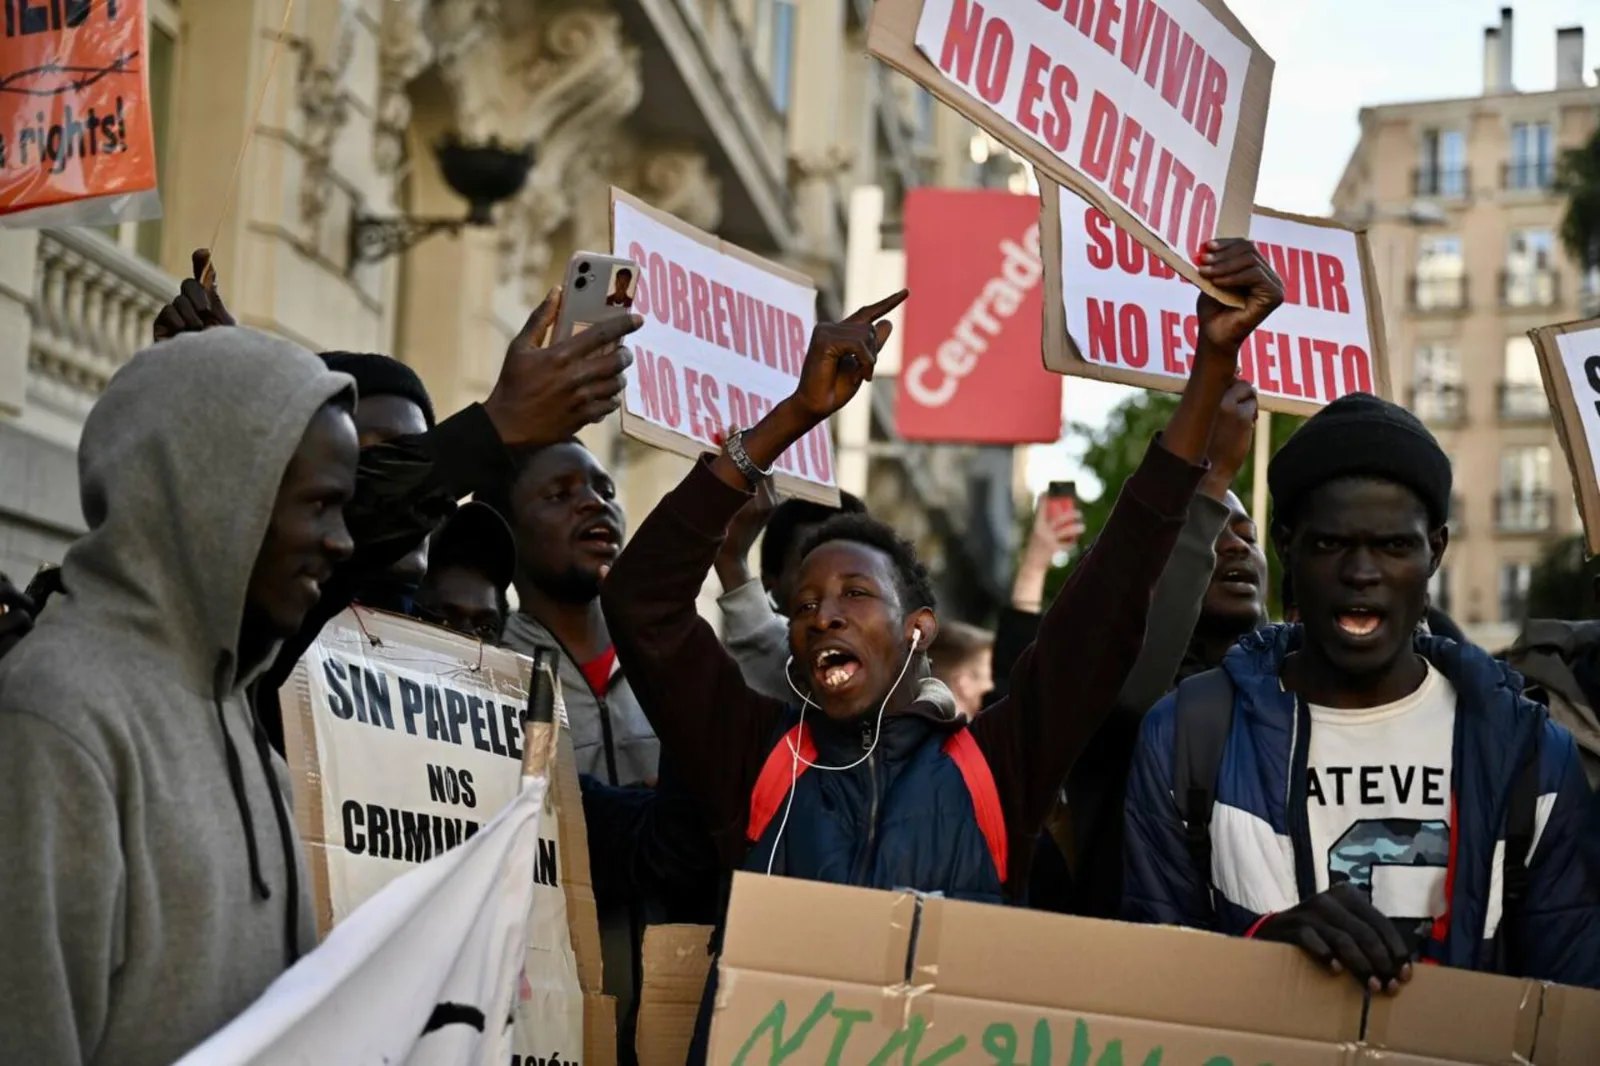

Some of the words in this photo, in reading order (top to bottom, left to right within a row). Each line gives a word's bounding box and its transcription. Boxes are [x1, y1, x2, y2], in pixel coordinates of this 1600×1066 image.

[1037, 0, 1228, 147] EVIVIR
[19, 95, 127, 173] rights!
[939, 0, 1014, 105] NO
[1016, 43, 1078, 152] ES
[1079, 90, 1217, 265] DELITO
[629, 241, 806, 378] SOBREVIVIR
[1086, 297, 1149, 368] NO
[634, 345, 681, 429] NO
[683, 365, 725, 446] ES
[322, 657, 395, 730] SIN
[427, 763, 477, 808] NOS
